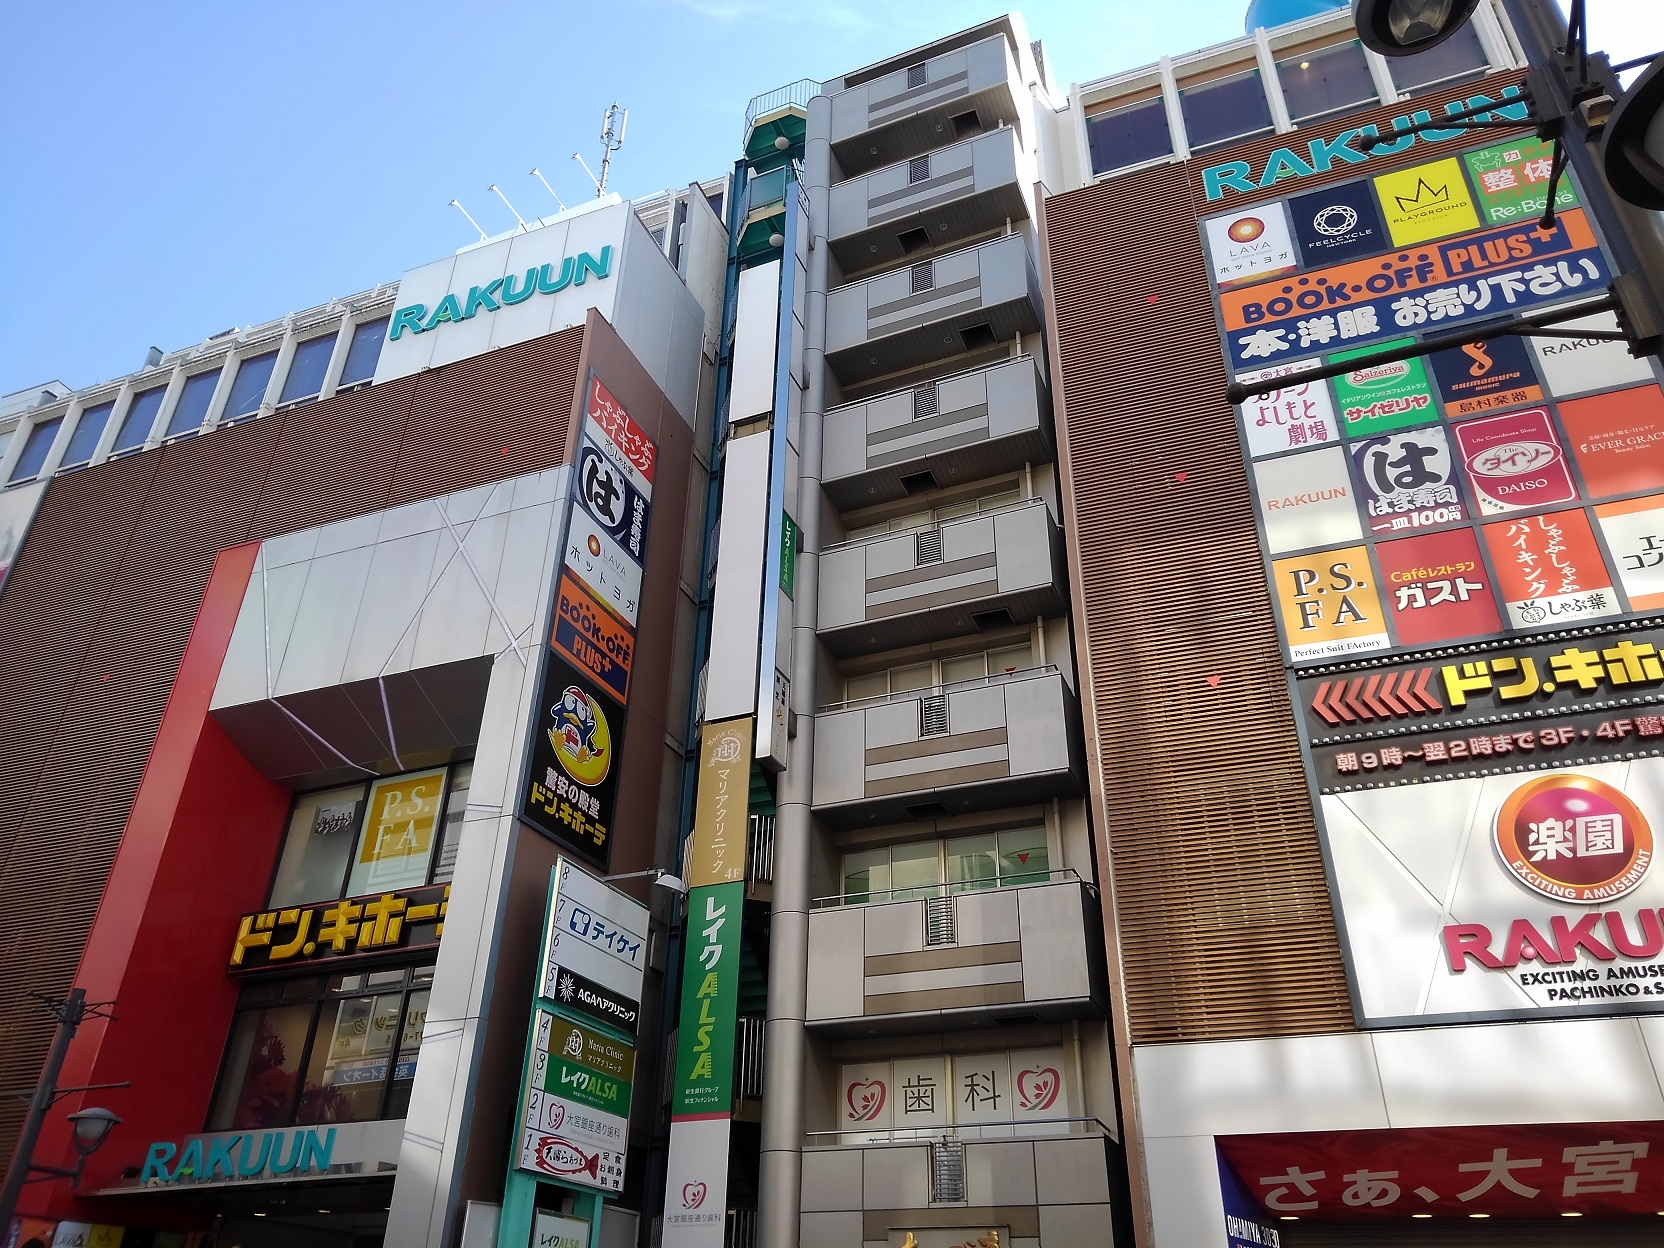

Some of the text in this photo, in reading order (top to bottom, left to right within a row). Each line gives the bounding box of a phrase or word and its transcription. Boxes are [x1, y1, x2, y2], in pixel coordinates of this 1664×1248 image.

[1202, 86, 1529, 202] RAKUUN
[1482, 159, 1552, 192] 整体
[1392, 202, 1467, 224] PLAYGROUND
[1229, 241, 1271, 257] LAVA
[1308, 229, 1373, 248] FEELCYCLE
[1220, 251, 1288, 274] ホットヨガ
[389, 245, 613, 341] RAKUUN
[1239, 258, 1600, 359] 本・洋服 お売り下さい
[1351, 364, 1405, 384] Saizeriya
[1255, 399, 1317, 427] よしもと
[1345, 393, 1432, 423] サイゼリヤ
[1459, 391, 1528, 413] 島村楽器
[595, 382, 653, 460] しゃぶしゃぶ
[1288, 420, 1329, 447] 劇場
[1471, 427, 1537, 444] Life Coordinate Shop
[592, 408, 652, 471] バイキング
[1503, 446, 1519, 454] The
[1590, 431, 1664, 452] EVER GRAC
[1371, 441, 1443, 495] は
[585, 458, 621, 526] は
[1267, 487, 1347, 511] RAKUUN
[1367, 485, 1459, 517] はま寿司
[1497, 478, 1548, 496] DAISO
[1371, 507, 1462, 531] 一皿100円
[1536, 515, 1581, 594] しゃぶしゃぶ
[1638, 534, 1664, 552] エ
[603, 548, 627, 577] LAVA
[1505, 519, 1549, 599] バイキング
[570, 545, 636, 613] ホットヨガ
[1289, 562, 1368, 599] P.S.
[1394, 576, 1484, 612] ガスト
[1547, 593, 1607, 616] しゃぶ葉
[1294, 639, 1381, 658] Perfect Suit FActory
[706, 728, 747, 747] Maria Clinic
[379, 785, 430, 820] P.S.
[545, 766, 600, 820] 驚安の殿堂
[711, 768, 731, 874] マリアクリニック
[1527, 813, 1625, 862] 楽園
[724, 867, 741, 880] 4F
[1511, 848, 1652, 901] EXCITING AMUSEMENT
[591, 921, 641, 962] テイケイ
[1443, 907, 1664, 972] RAKU
[689, 895, 727, 1080] レイクALSA
[1520, 968, 1600, 986] EXCITING
[1546, 982, 1641, 1001] PACHINKO
[1643, 985, 1655, 995] &
[577, 988, 637, 1022] AGAヘアクリニック
[587, 1054, 622, 1073] マリアクリニック
[560, 1065, 619, 1101] レイクALSA
[566, 1112, 622, 1141] 大宮銀座通り歯科
[139, 1127, 338, 1184] RAKUUN
[666, 1213, 722, 1225] 大宮銀座通り歯科
